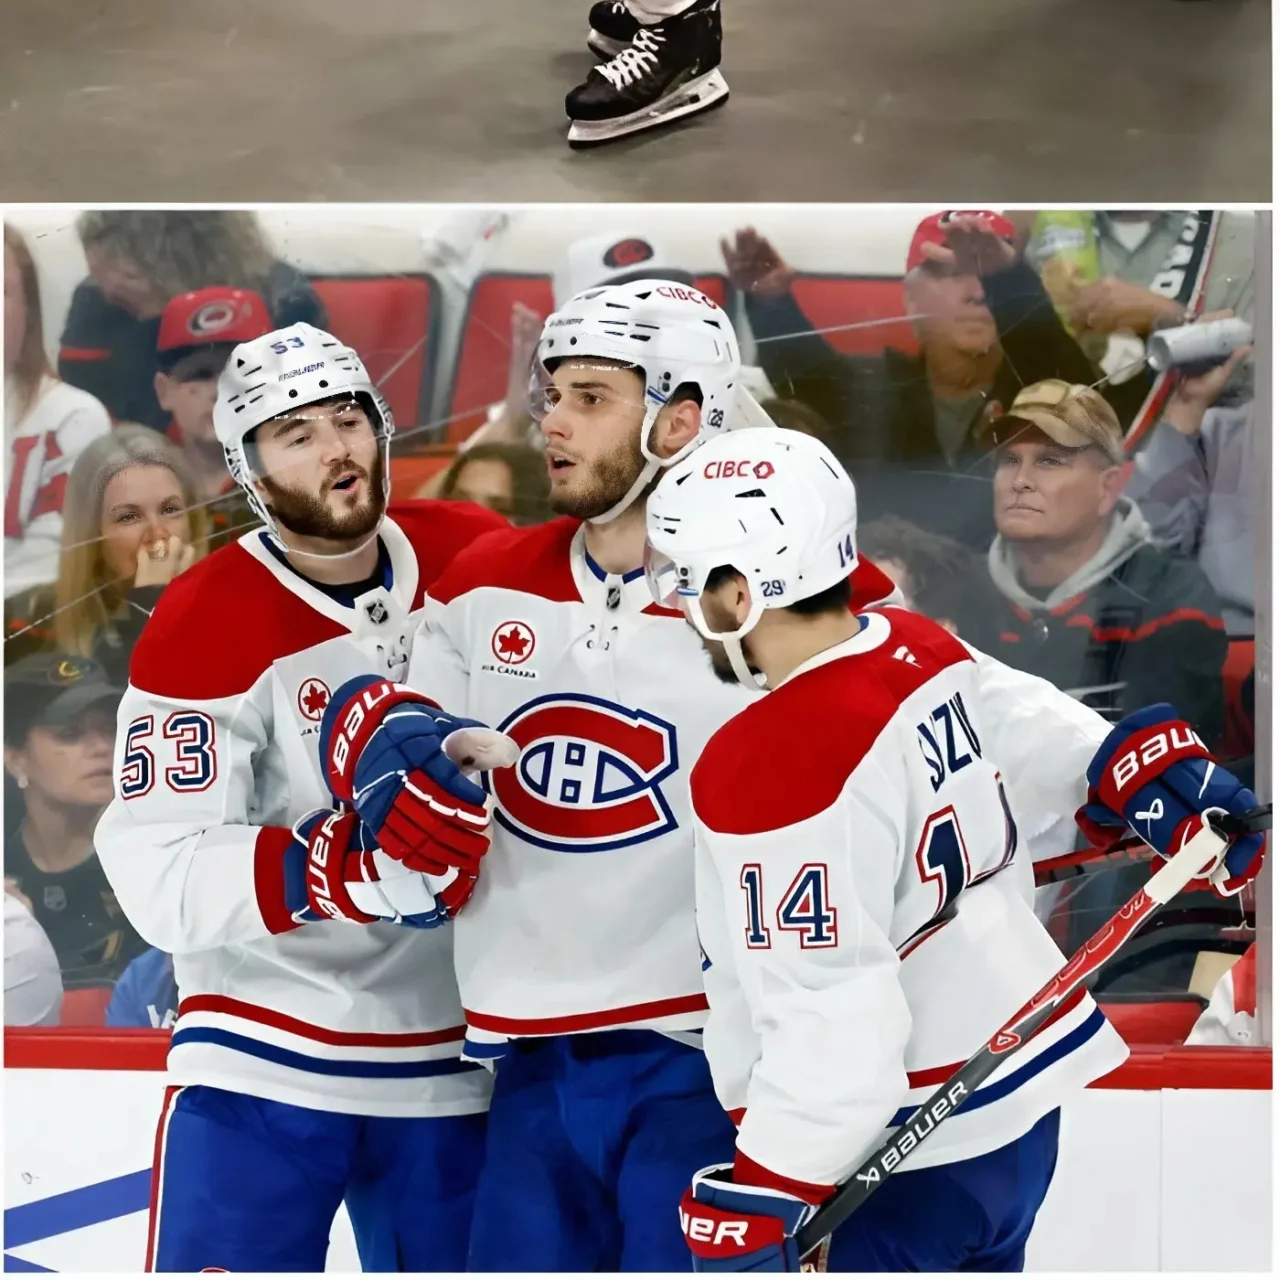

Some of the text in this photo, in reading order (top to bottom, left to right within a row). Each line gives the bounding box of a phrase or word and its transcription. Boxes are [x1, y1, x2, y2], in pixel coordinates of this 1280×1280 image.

[270, 336, 305, 355] 53
[703, 461, 751, 479] CIBC
[837, 534, 855, 569] 14
[120, 710, 217, 801] 53
[740, 862, 838, 950] 14
